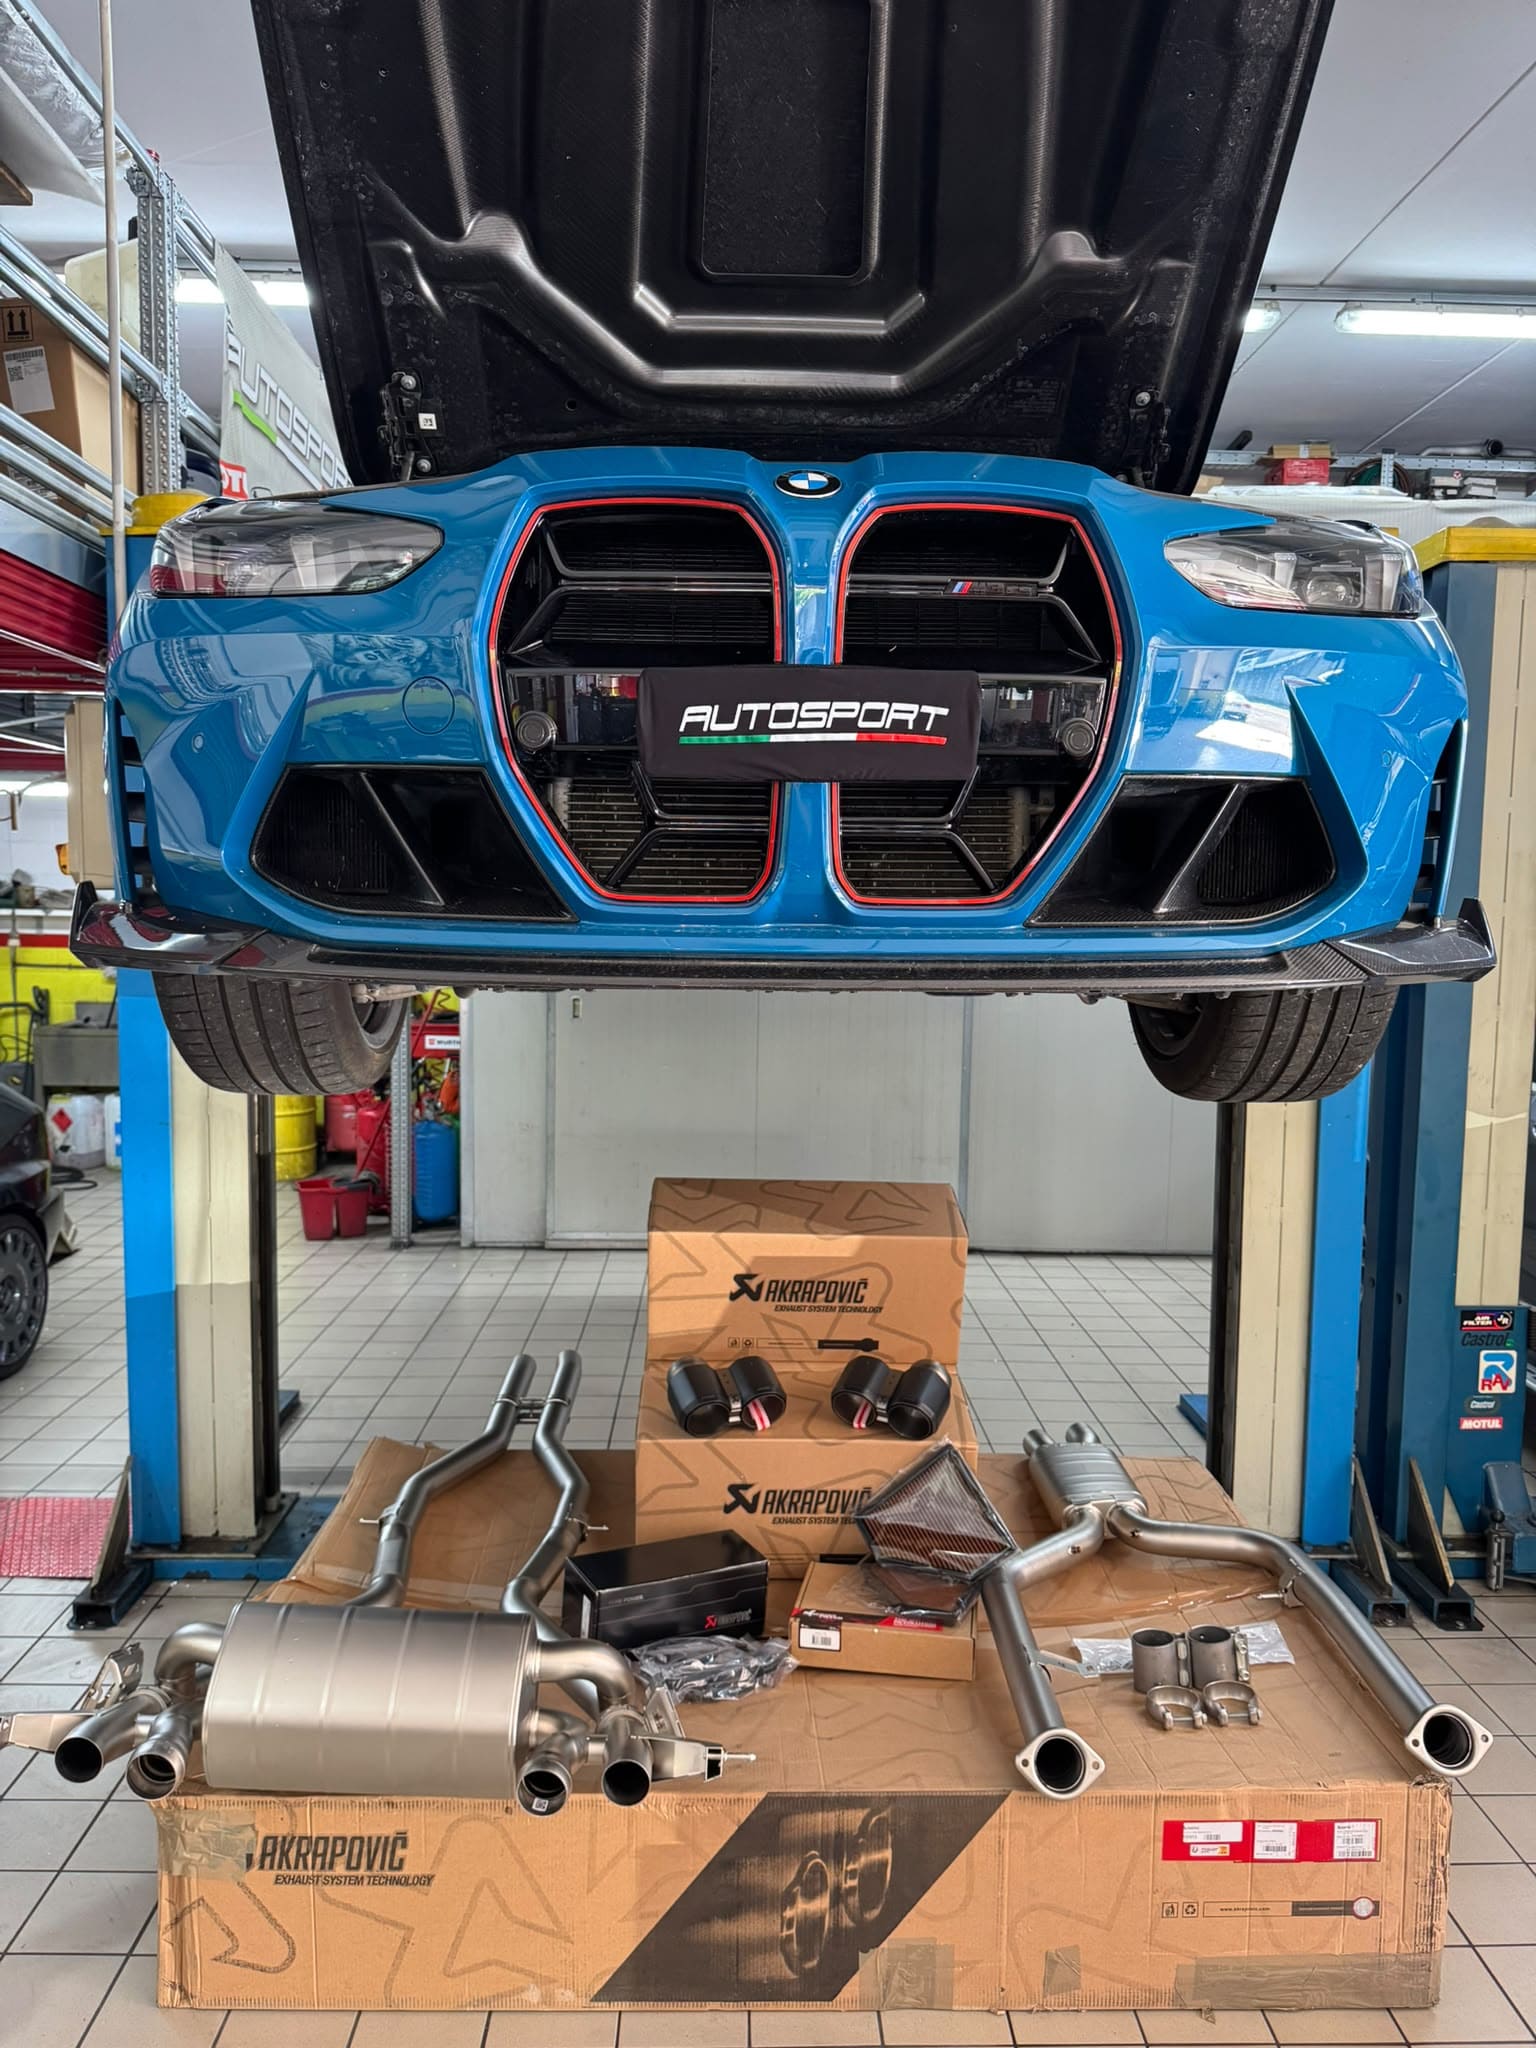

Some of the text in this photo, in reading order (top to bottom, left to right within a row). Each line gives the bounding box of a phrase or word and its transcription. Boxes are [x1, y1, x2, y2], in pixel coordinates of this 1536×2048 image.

[679, 701, 949, 732] AUTOSPORT
[774, 1304, 883, 1314] EXHAUST SYSTEM TECHNOLOGY
[1461, 1332, 1510, 1347] Castrol
[1481, 1373, 1509, 1391] RAV
[1462, 1419, 1502, 1429] MOTUL
[772, 1516, 807, 1525] EXHAUST
[808, 1516, 840, 1525] SYSTEM
[274, 1874, 435, 1887] EXHAUST SYSTEM TECHNOLOGY
